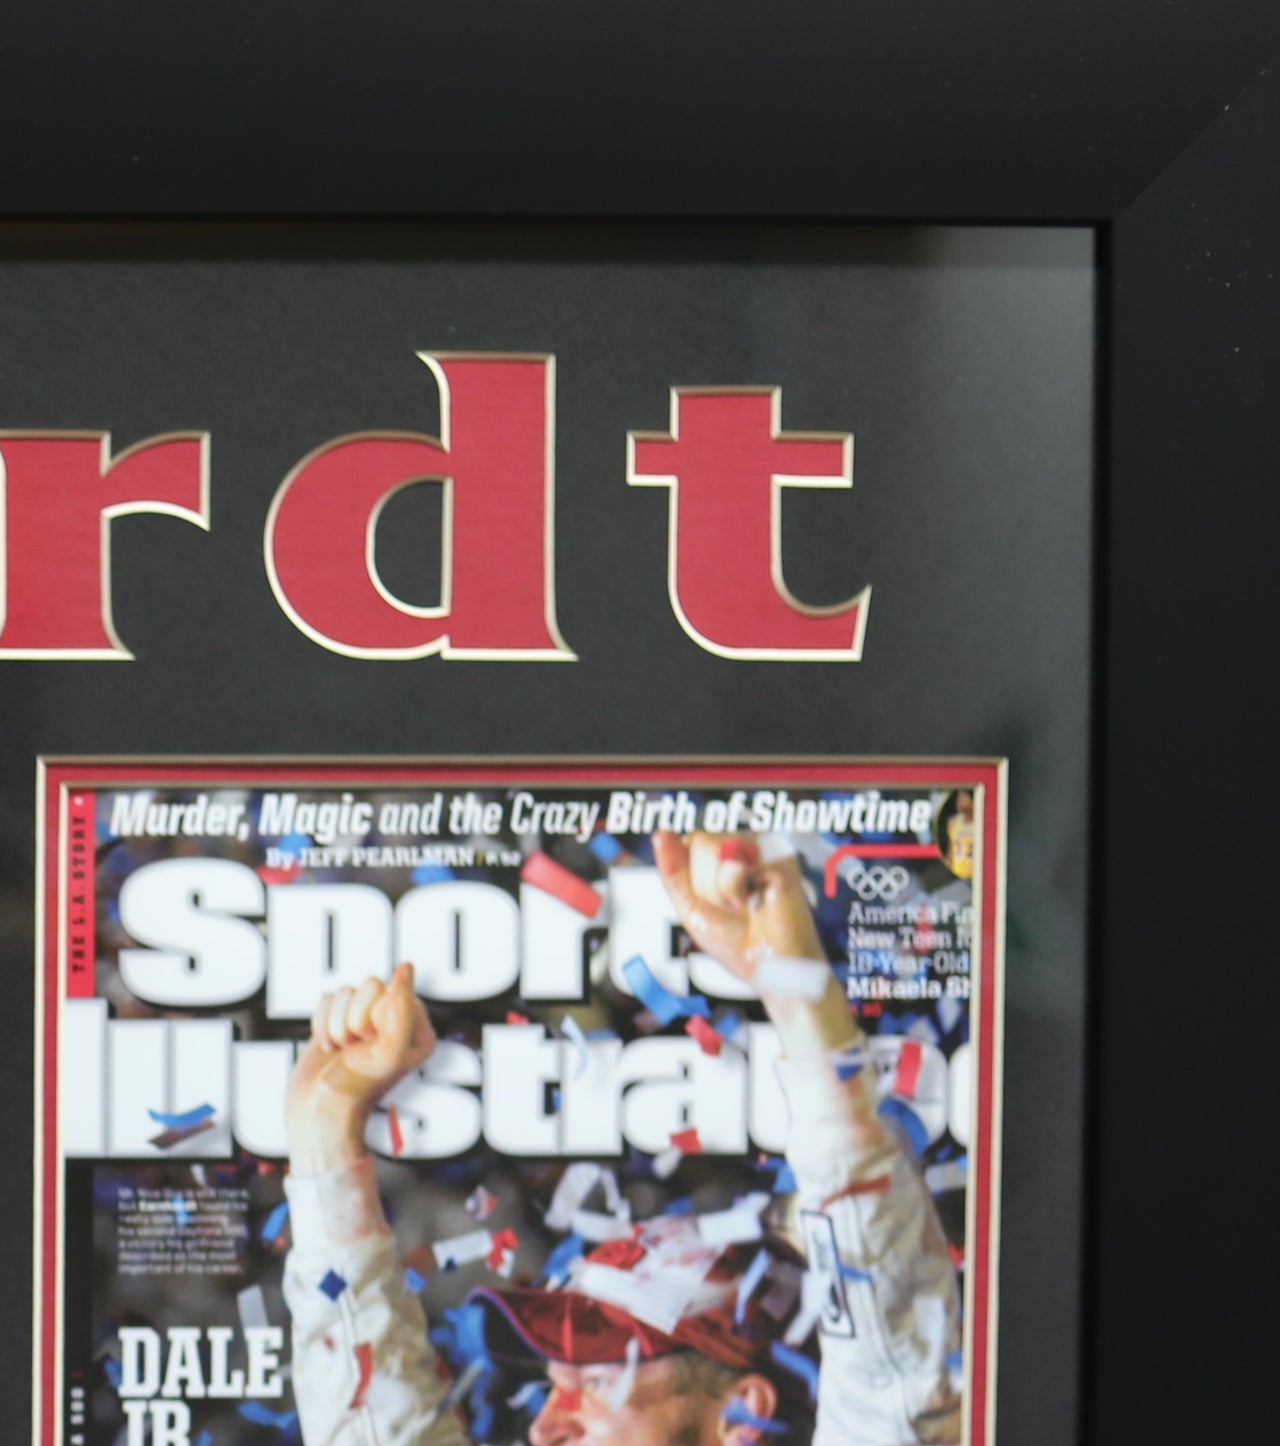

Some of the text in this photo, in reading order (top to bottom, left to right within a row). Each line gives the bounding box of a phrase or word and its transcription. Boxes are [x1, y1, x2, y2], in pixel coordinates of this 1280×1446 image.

[110, 790, 932, 844] Murder, Magic and the Crazy Birth of Showtime
[298, 847, 350, 867] JEFF
[354, 847, 474, 867] PEARLMAN
[118, 1326, 283, 1399] DALE
